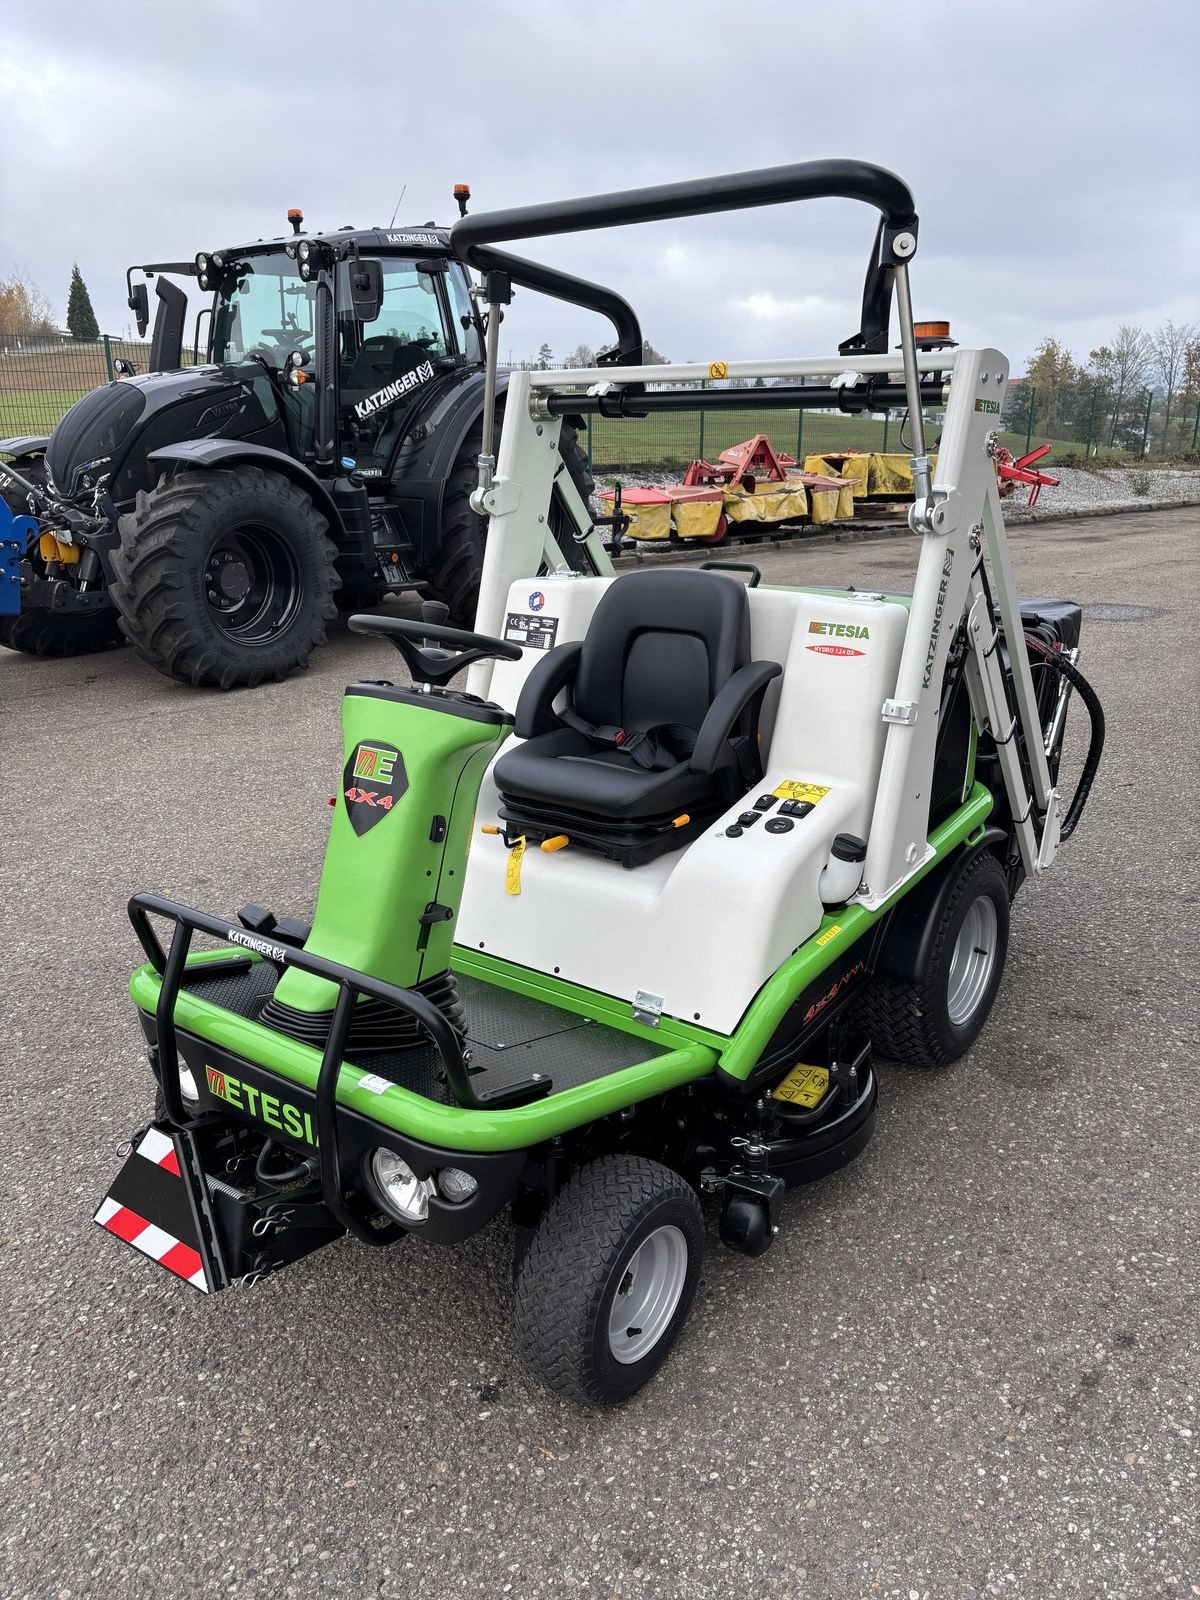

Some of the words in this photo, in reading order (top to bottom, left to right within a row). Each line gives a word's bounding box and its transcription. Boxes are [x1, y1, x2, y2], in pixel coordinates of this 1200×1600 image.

[386, 233, 428, 242] KATZINGER
[354, 370, 419, 418] KATZINGER
[922, 579, 948, 689] KATZINGER
[814, 646, 834, 654] HYDRO
[835, 648, 846, 656] 124
[228, 929, 273, 957] KATZINGER
